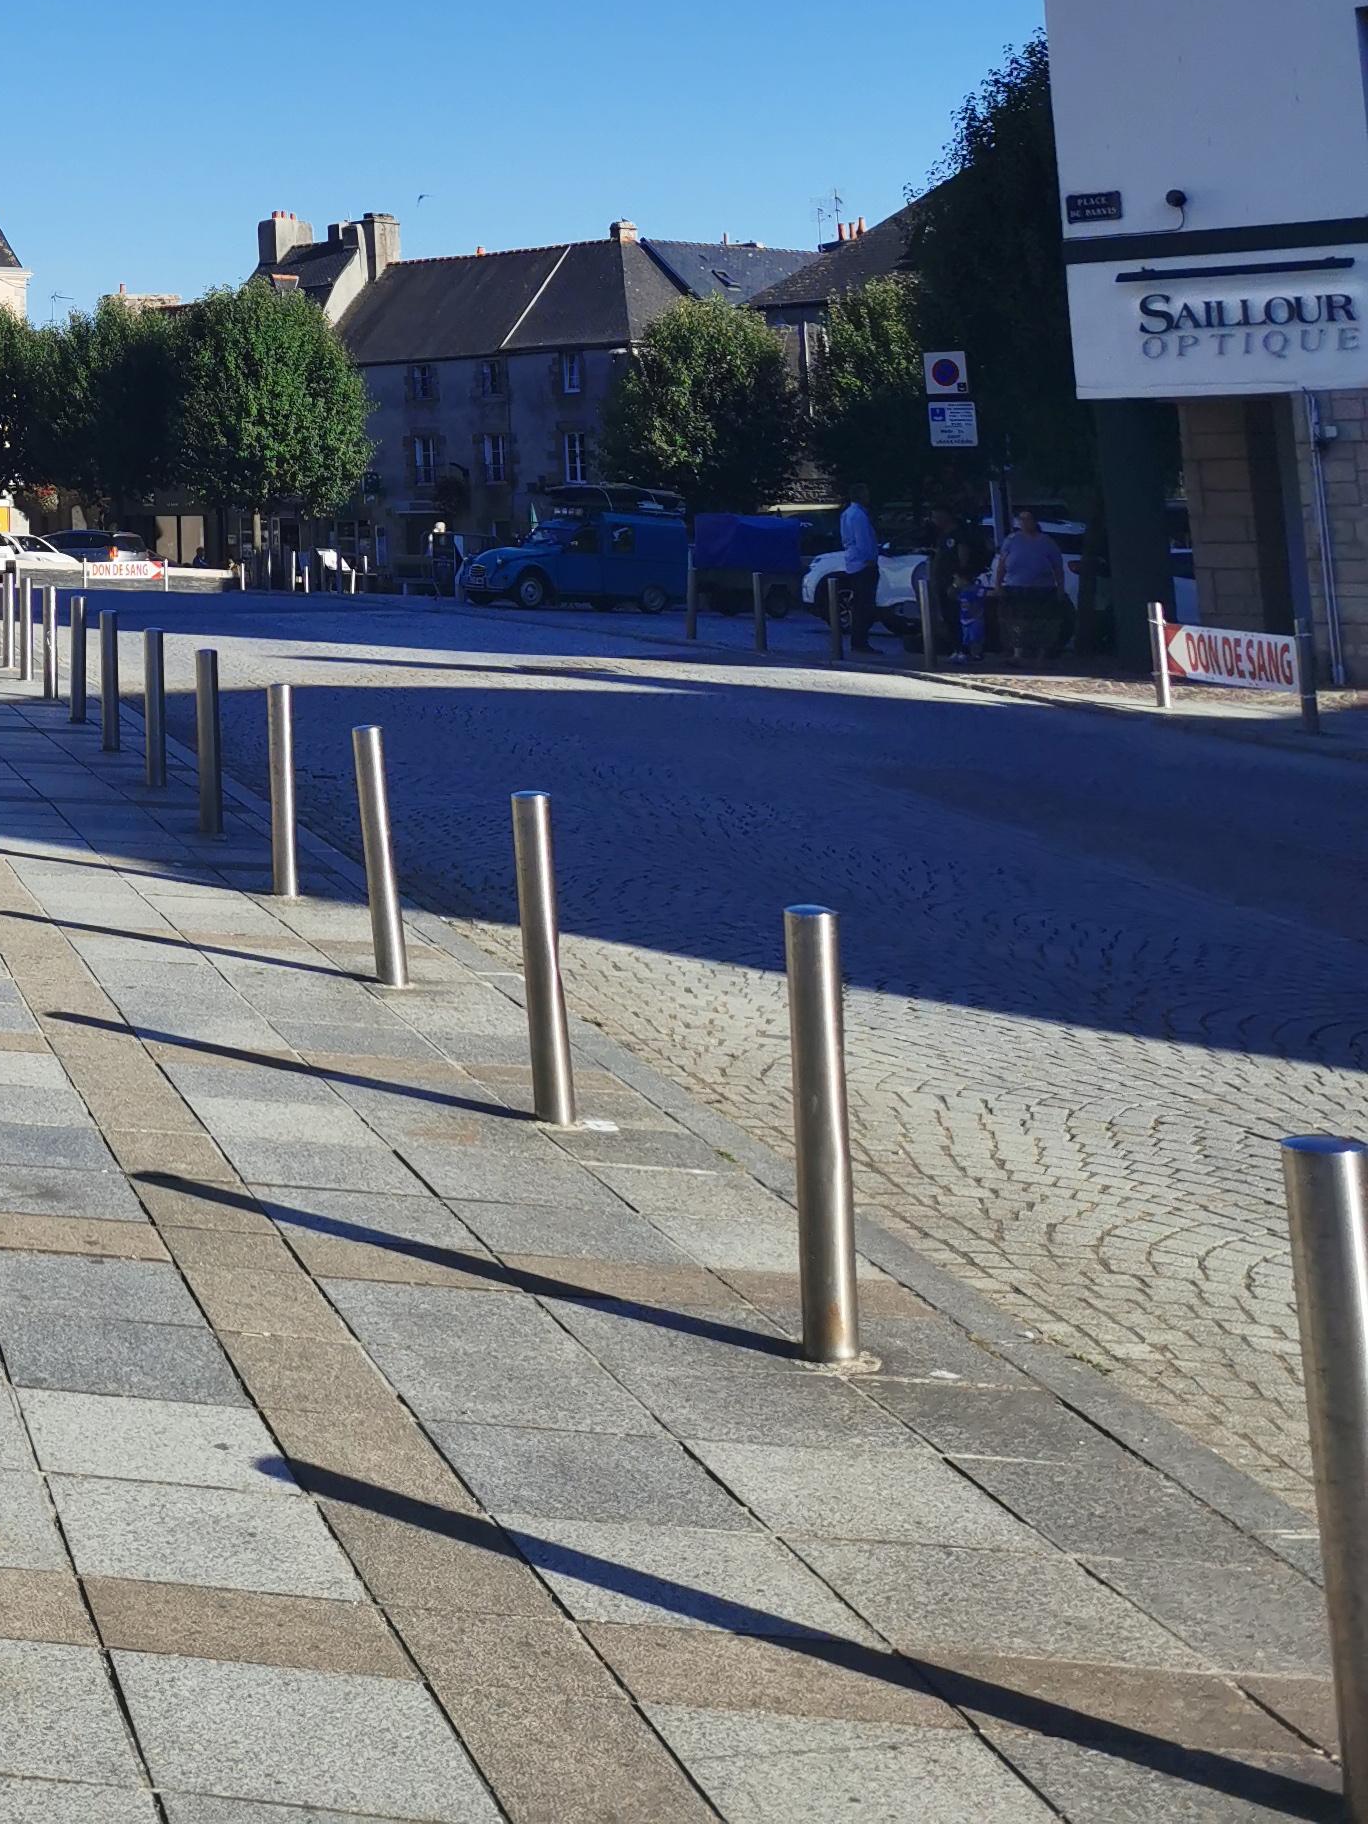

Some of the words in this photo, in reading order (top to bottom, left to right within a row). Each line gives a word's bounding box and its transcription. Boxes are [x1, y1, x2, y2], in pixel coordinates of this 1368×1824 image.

[1077, 196, 1107, 206] PLACE
[1085, 207, 1117, 216] PARVIS
[1140, 294, 1357, 334] SAILLOUR
[1142, 328, 1360, 359] OPTIQUE
[92, 564, 111, 576] DON
[113, 564, 124, 576] DE
[125, 564, 149, 576] SANG
[1185, 632, 1222, 676] DON
[1222, 636, 1246, 679] DE
[1246, 639, 1294, 686] SANG
